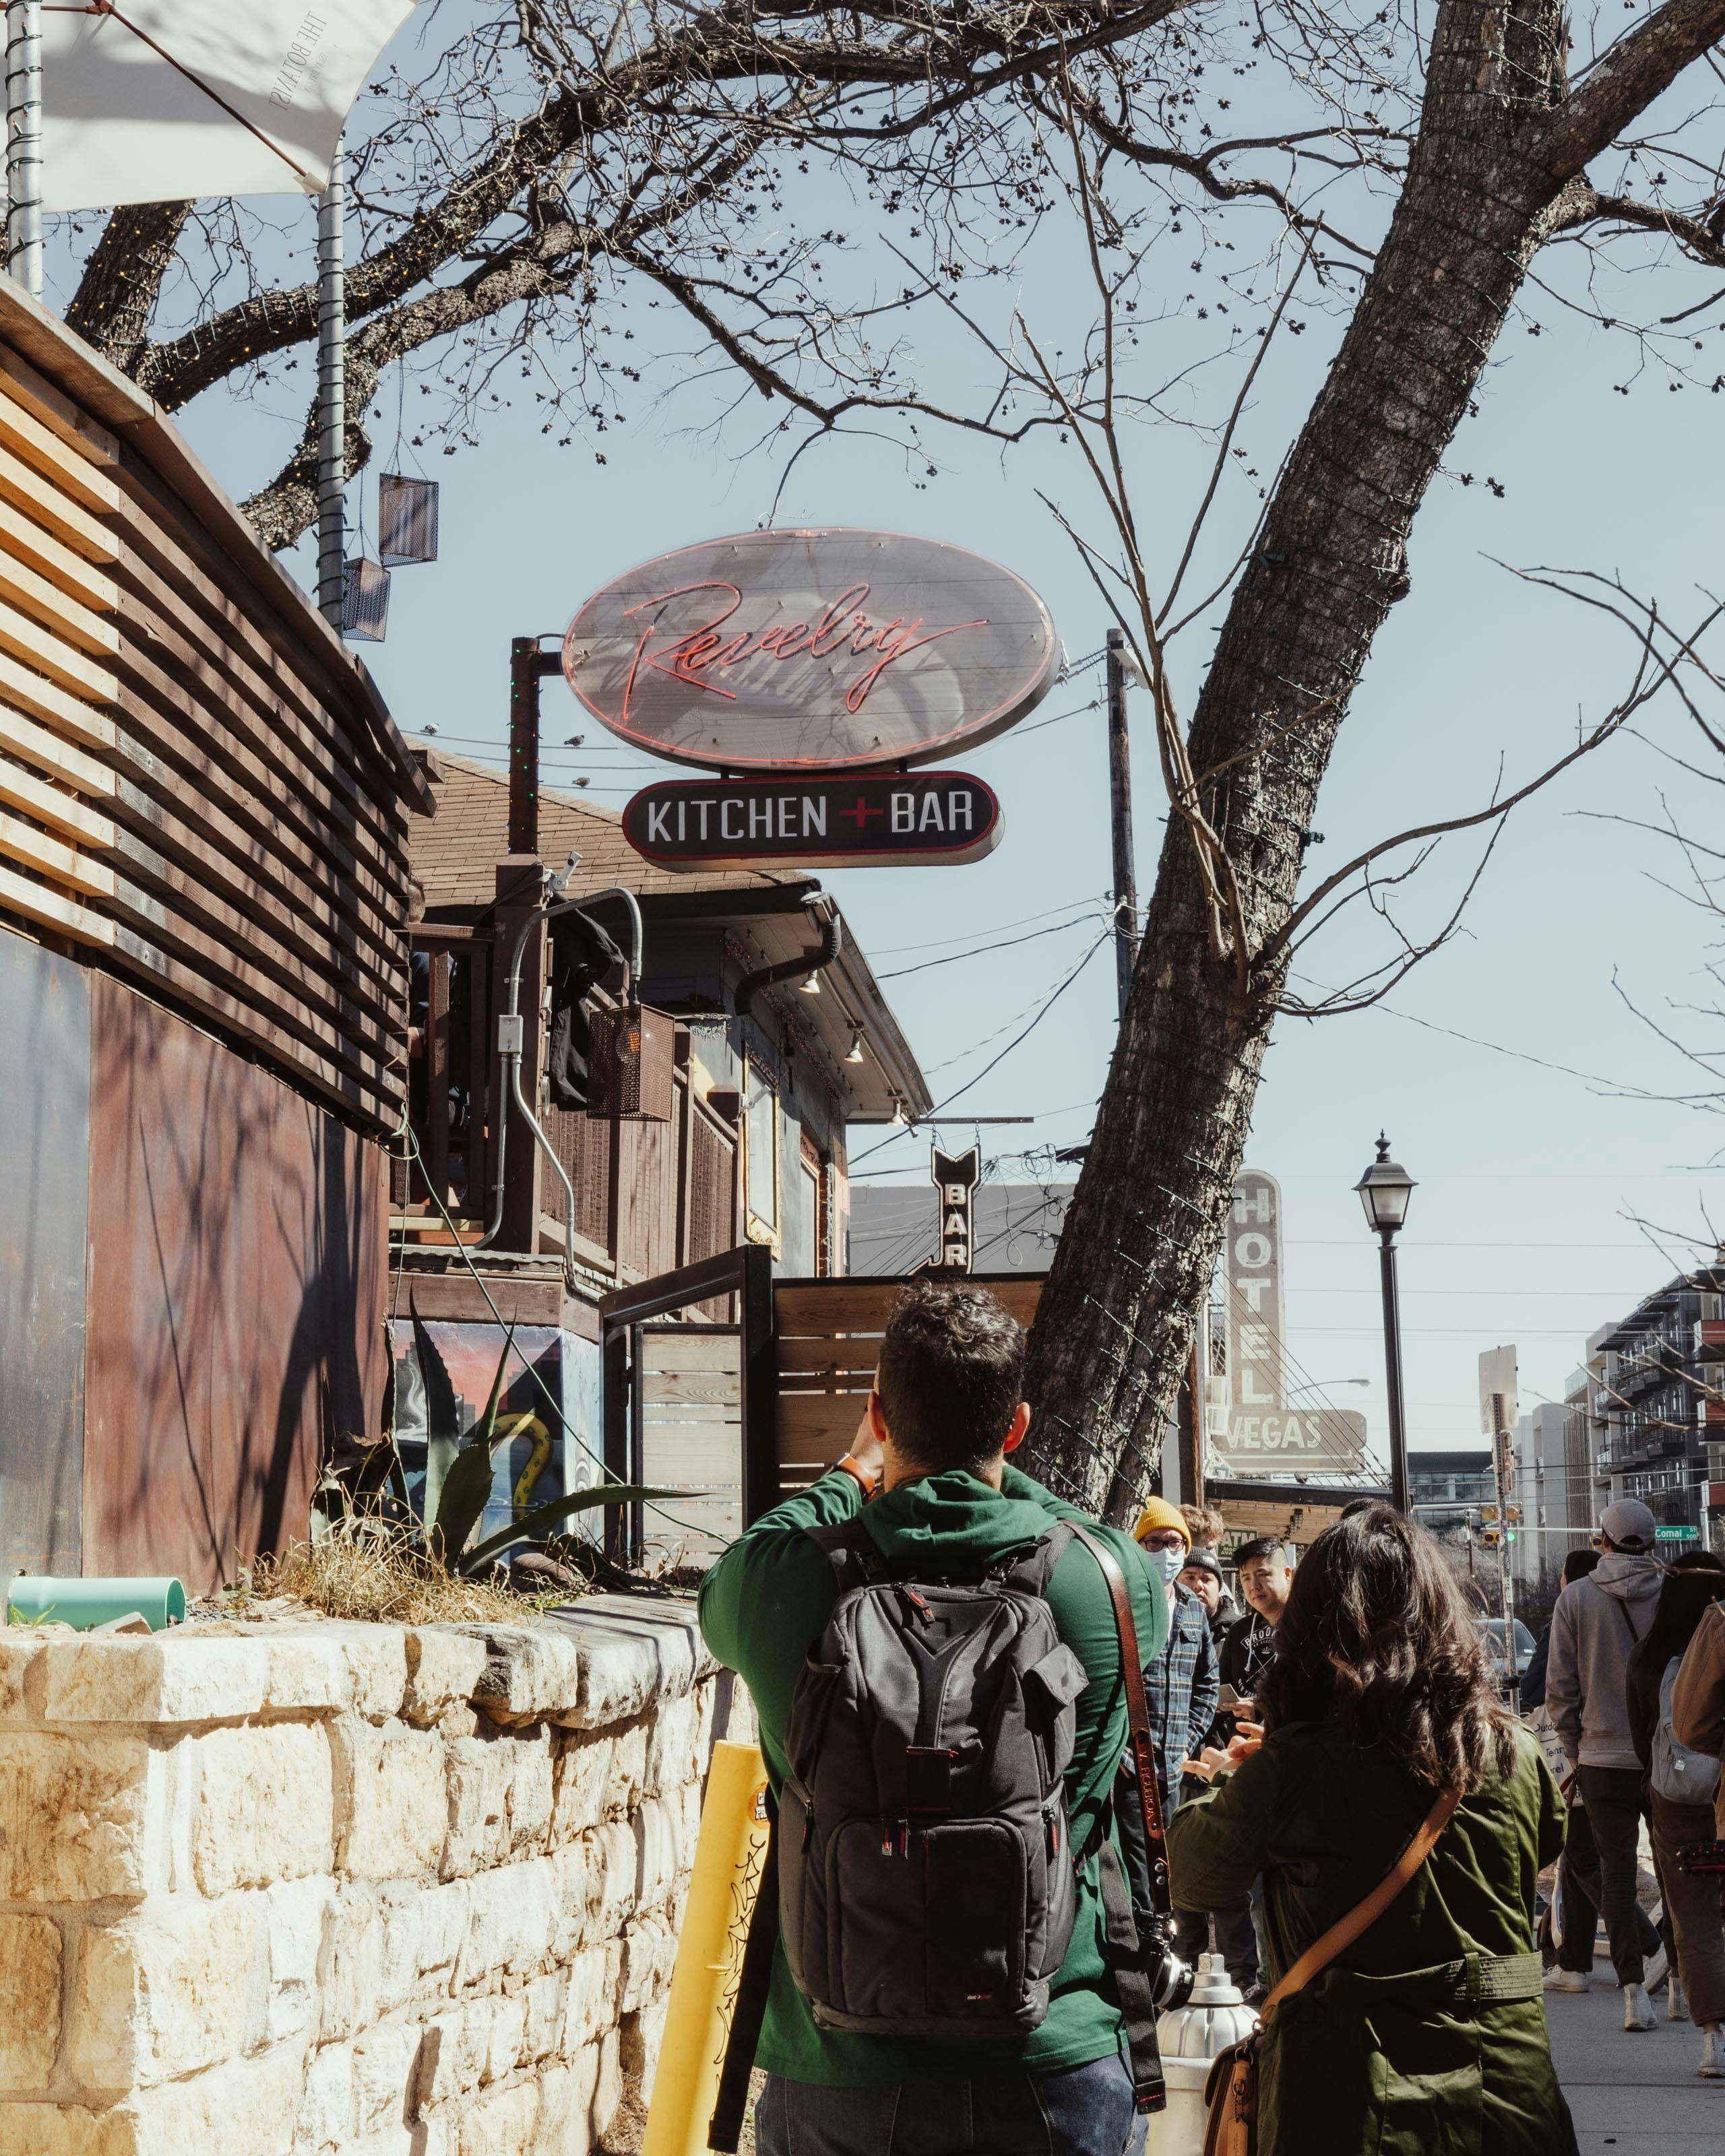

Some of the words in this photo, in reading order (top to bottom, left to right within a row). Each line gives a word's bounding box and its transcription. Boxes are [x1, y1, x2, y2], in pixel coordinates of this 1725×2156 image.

[624, 582, 991, 721] Revelry
[648, 795, 826, 842] KITCHEN
[891, 790, 972, 833] BAR
[944, 1184, 968, 1266] BAR
[1234, 1188, 1274, 1404] HOTEL
[1226, 1416, 1321, 1449] VEGAS
[1220, 1531, 1255, 1547] ATM
[1655, 1529, 1683, 1537] Comal
[1534, 1722, 1558, 1732] Outdo
[1546, 1746, 1563, 1757] Tenn
